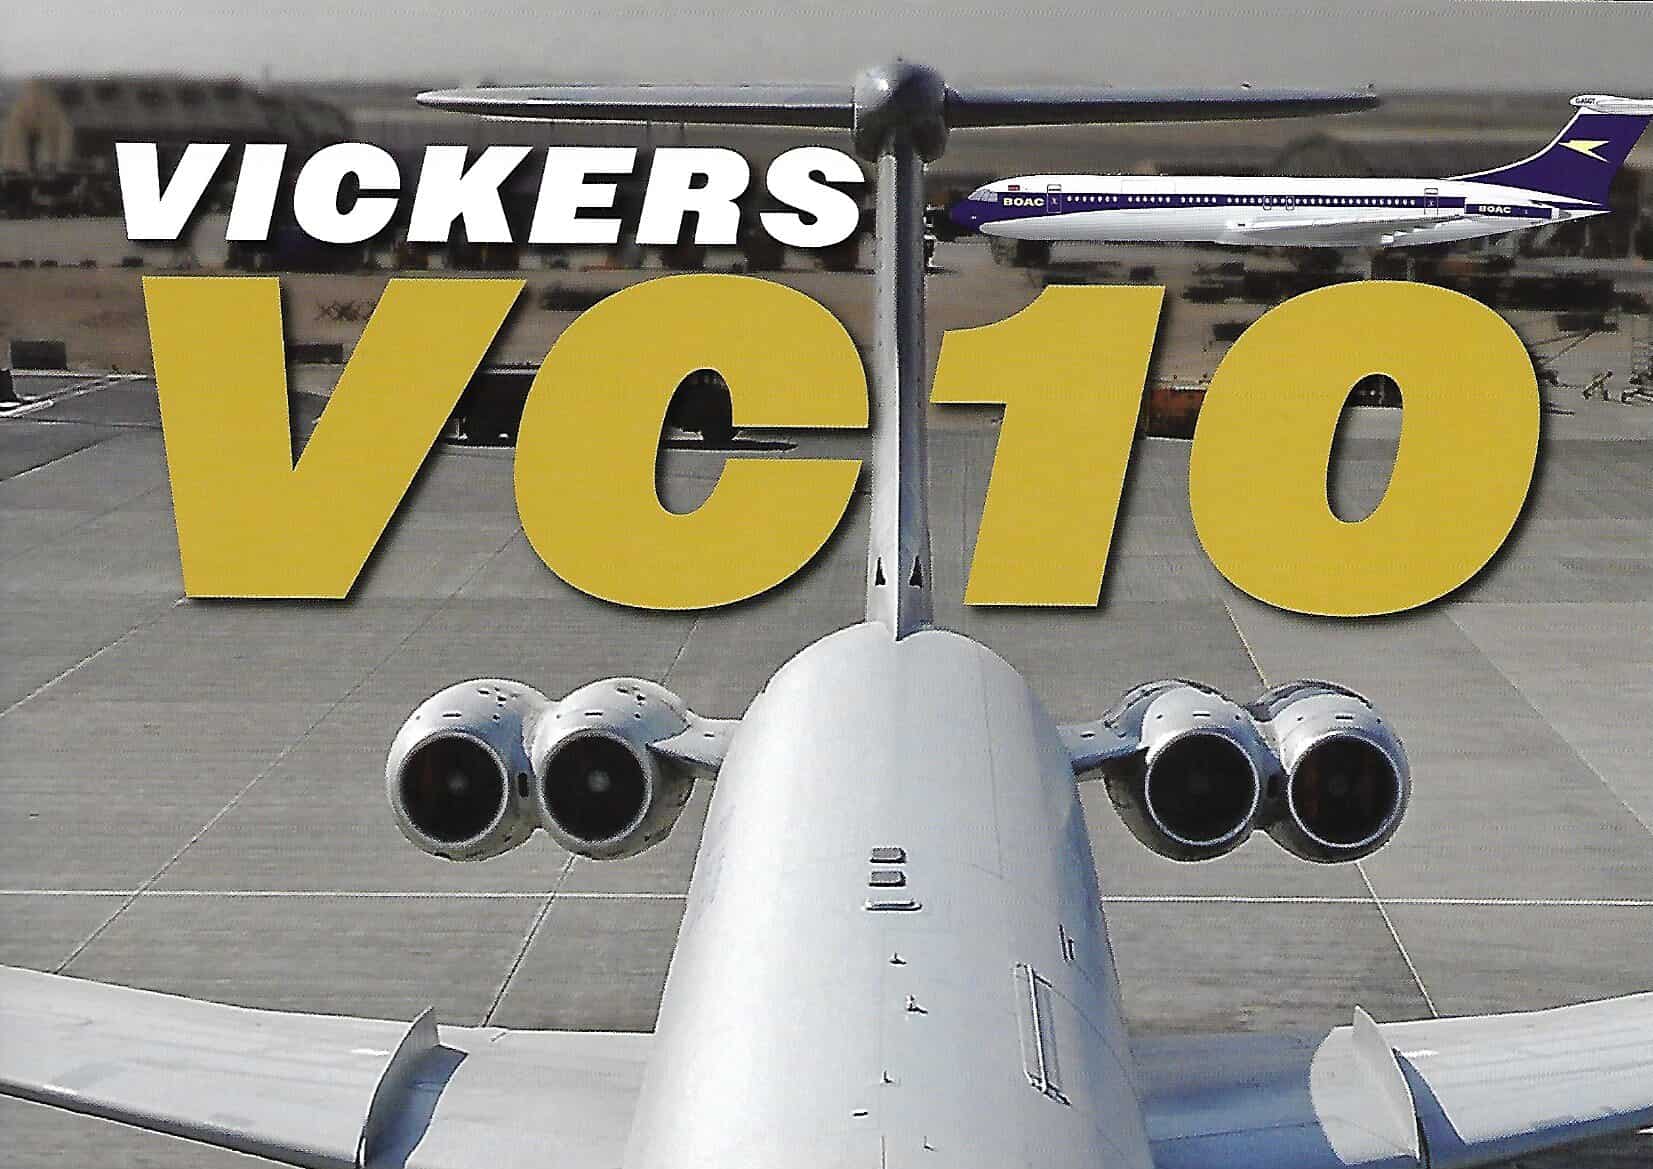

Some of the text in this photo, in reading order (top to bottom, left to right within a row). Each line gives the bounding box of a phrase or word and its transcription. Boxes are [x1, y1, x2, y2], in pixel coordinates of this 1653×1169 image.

[115, 142, 865, 248] VICKERS
[1003, 197, 1045, 207] BOAC
[1479, 205, 1512, 214] BOAC
[141, 275, 1541, 616] VC10
